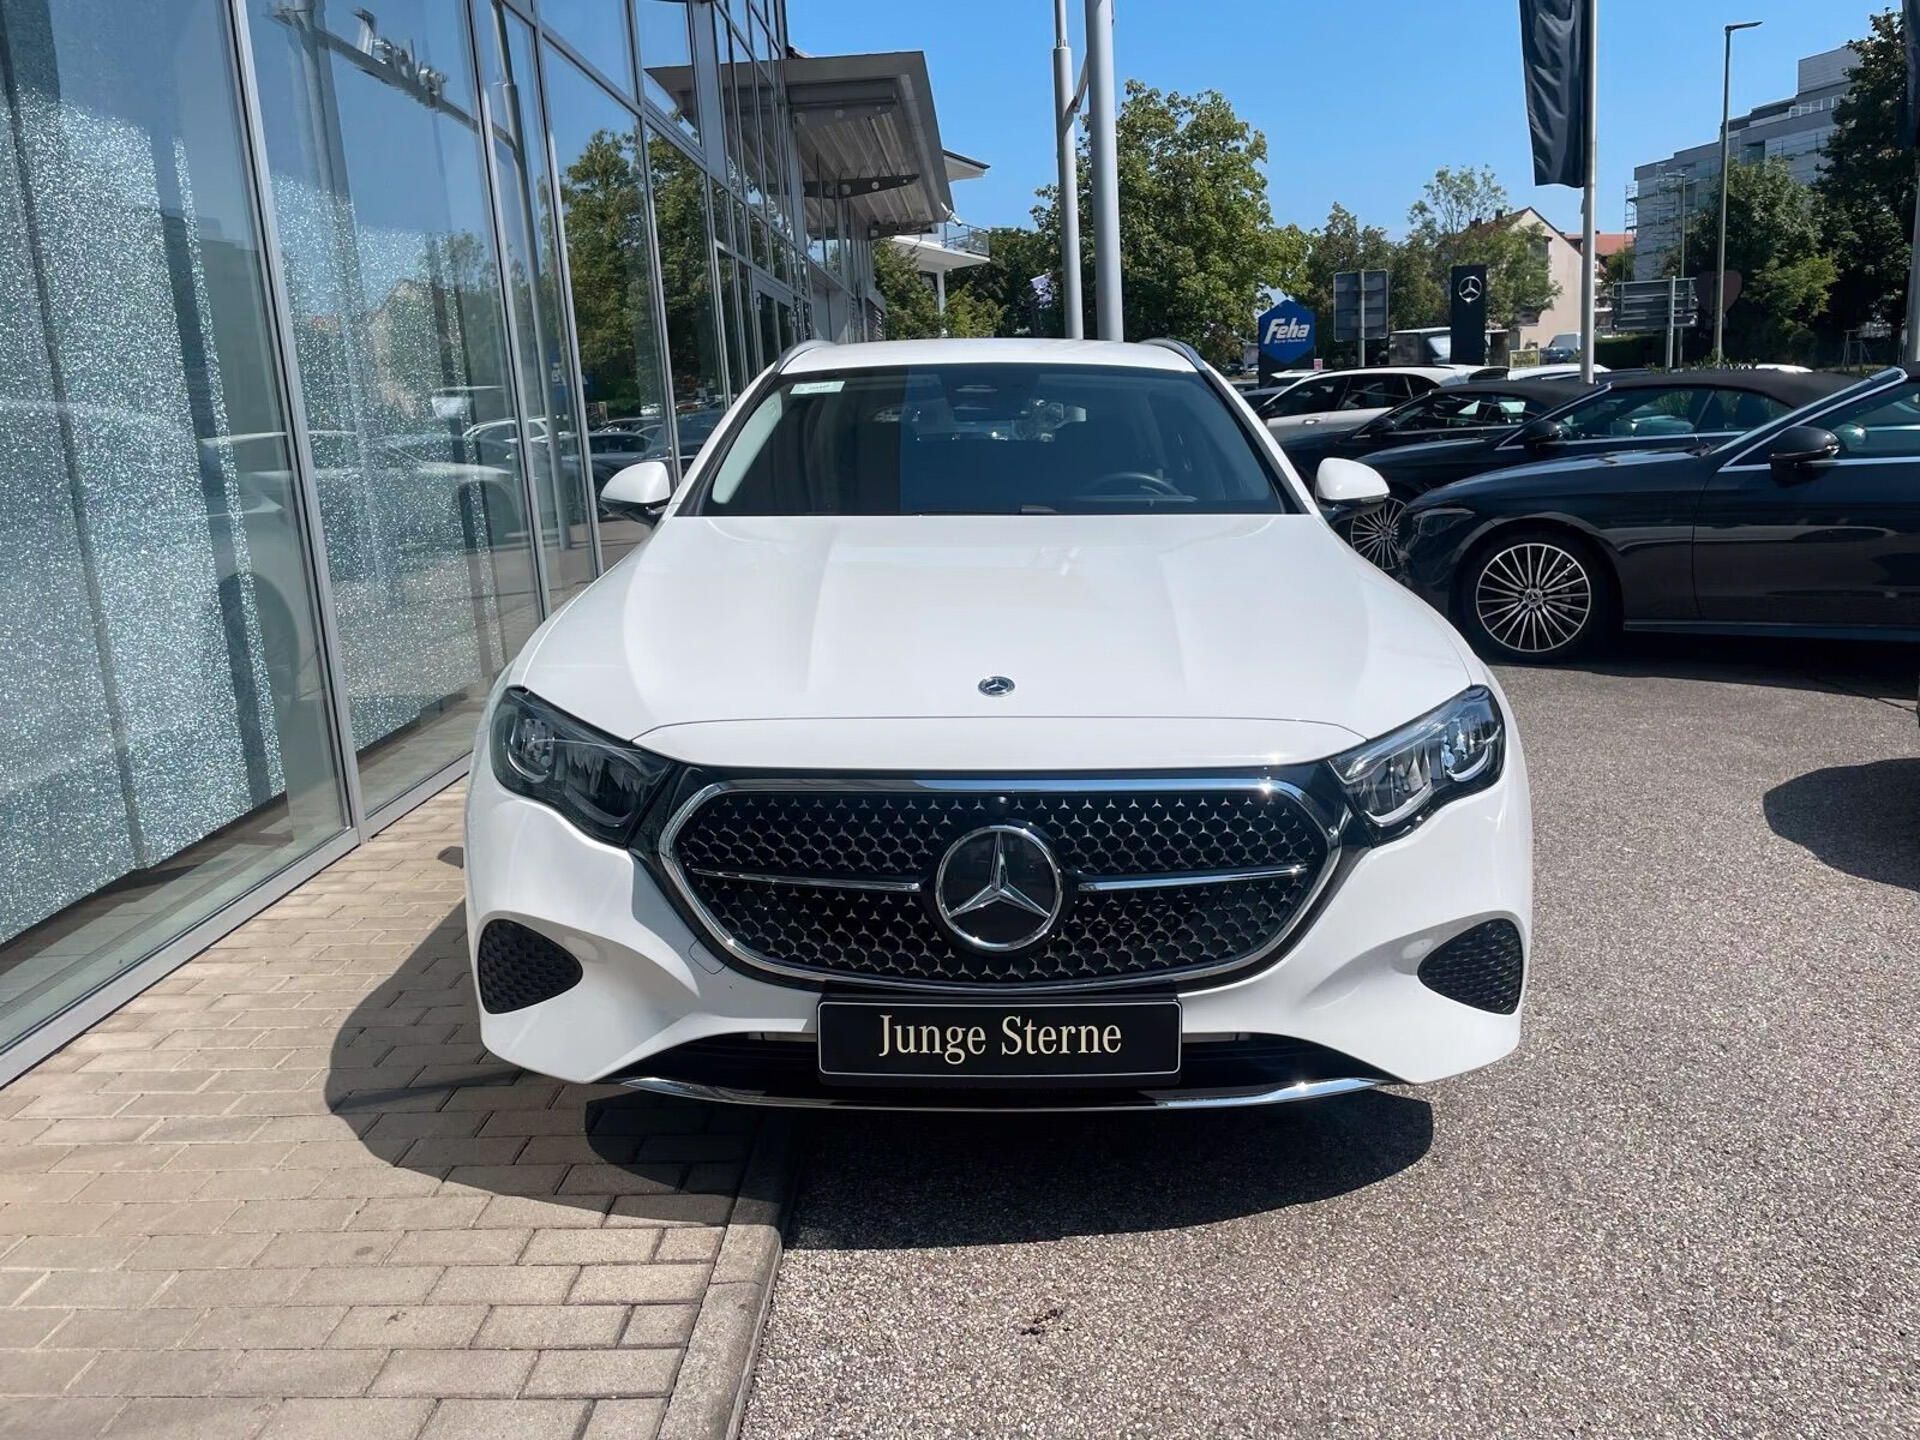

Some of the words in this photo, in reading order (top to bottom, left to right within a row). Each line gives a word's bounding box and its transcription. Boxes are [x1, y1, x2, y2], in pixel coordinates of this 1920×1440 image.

[1264, 317, 1310, 344] Feha
[878, 1014, 986, 1065] Junge
[1001, 1015, 1122, 1056] Sterne
